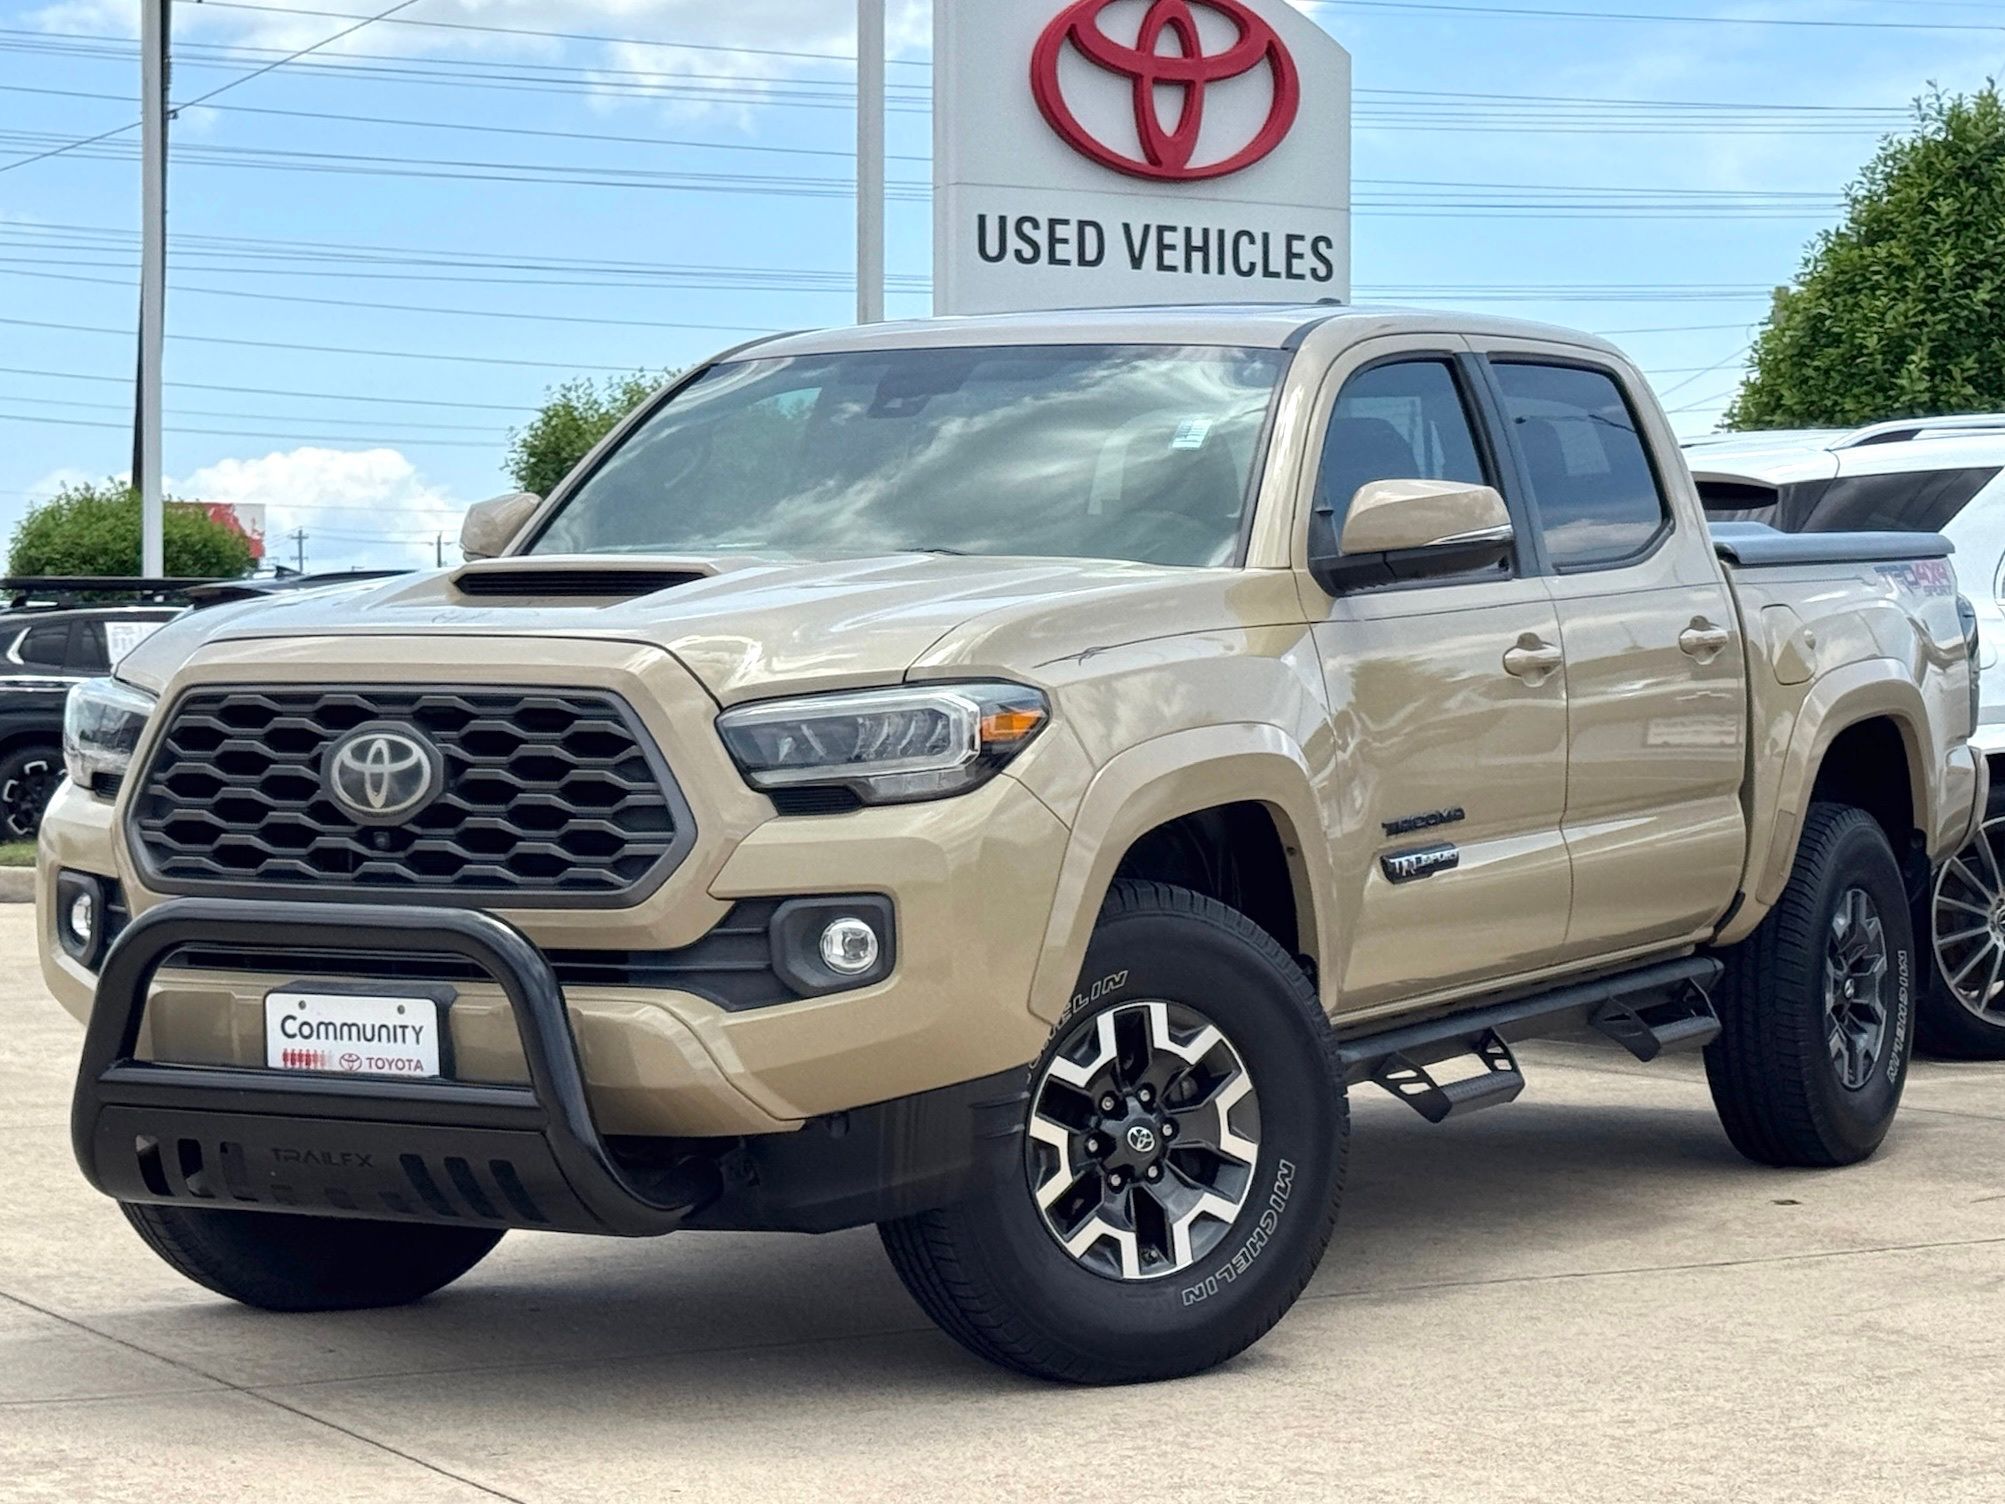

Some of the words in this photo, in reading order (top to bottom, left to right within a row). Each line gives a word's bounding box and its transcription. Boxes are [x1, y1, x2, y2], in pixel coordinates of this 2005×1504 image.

[976, 213, 1105, 268] USED
[1121, 221, 1334, 283] VEHICLES
[1884, 949, 1909, 1084] MICHELIN
[366, 1057, 424, 1072] TOYOTA
[271, 1147, 374, 1168] TRAILFX
[1181, 1158, 1296, 1307] MICHELIN
